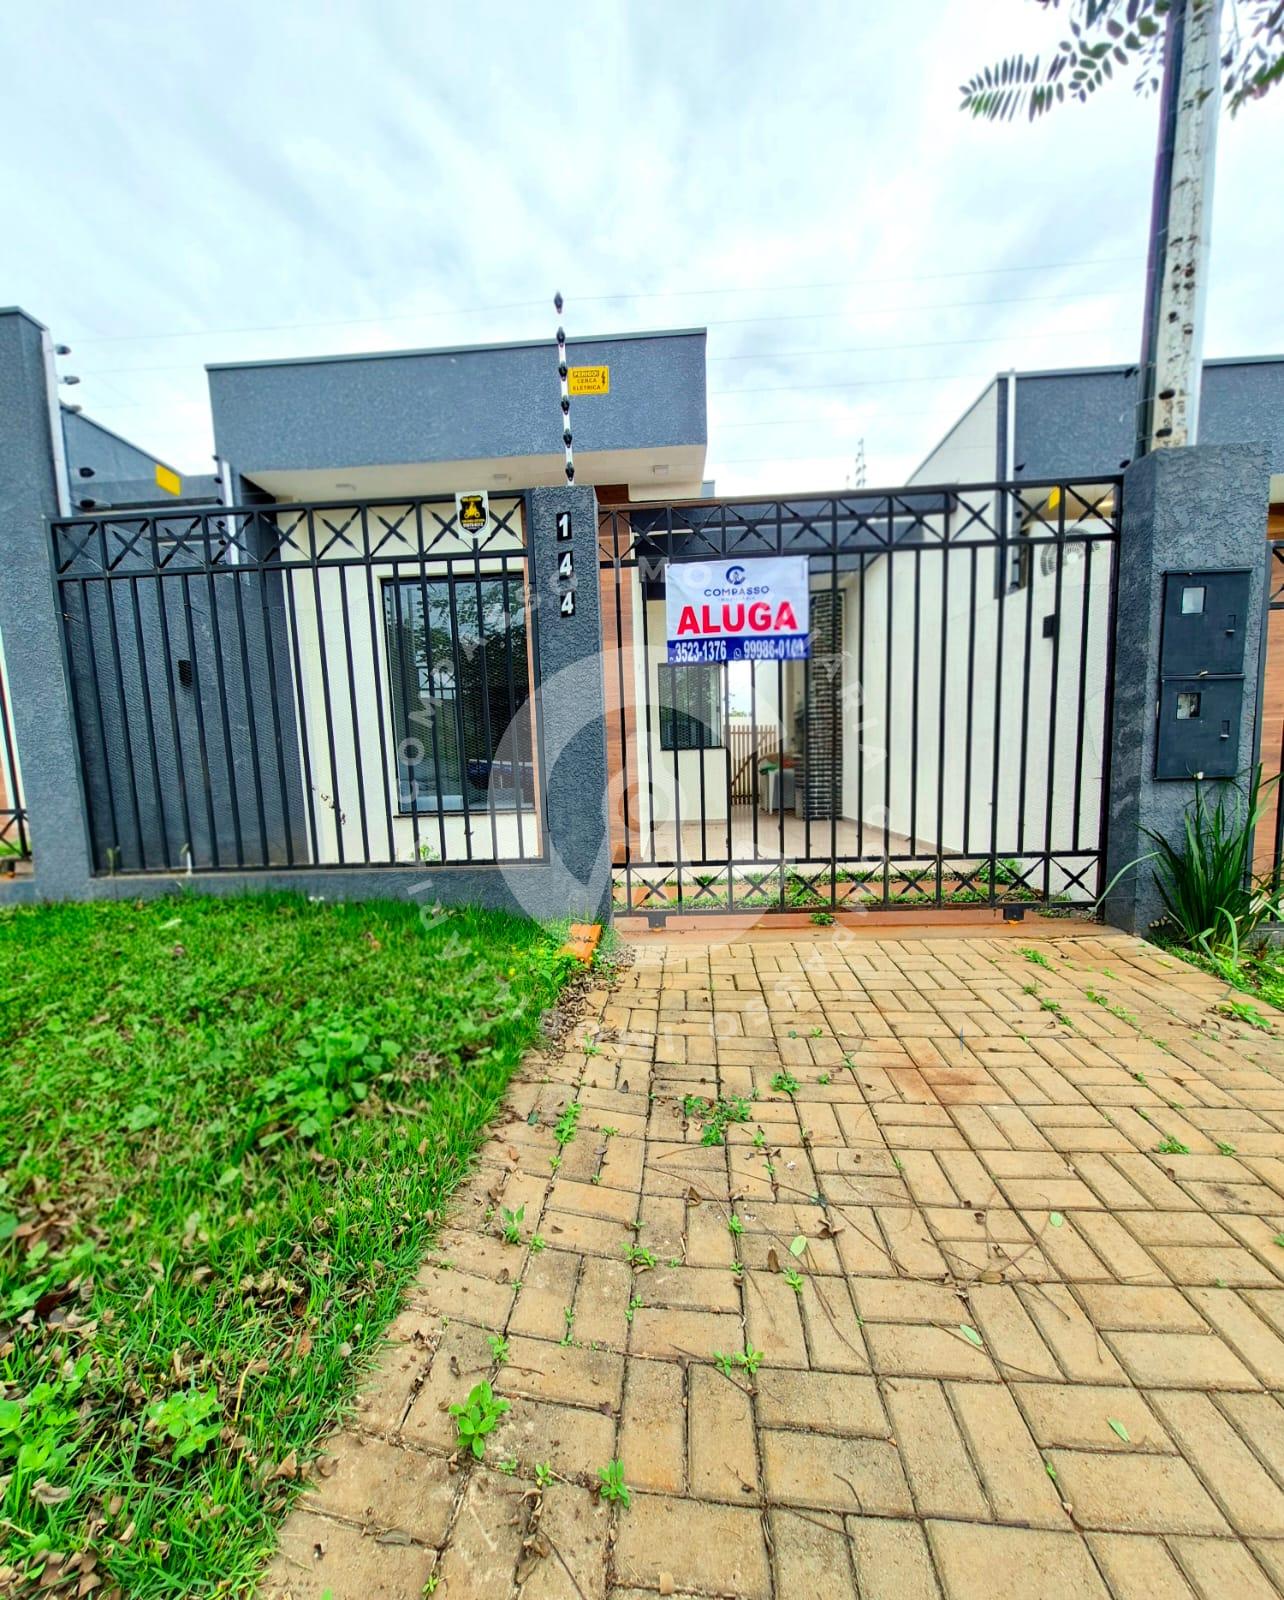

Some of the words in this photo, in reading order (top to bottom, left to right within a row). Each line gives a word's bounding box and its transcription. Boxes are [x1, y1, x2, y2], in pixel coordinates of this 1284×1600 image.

[704, 586, 770, 597] COMPASSO
[676, 601, 798, 635] ALUGA
[675, 640, 727, 662] 3523-1376
